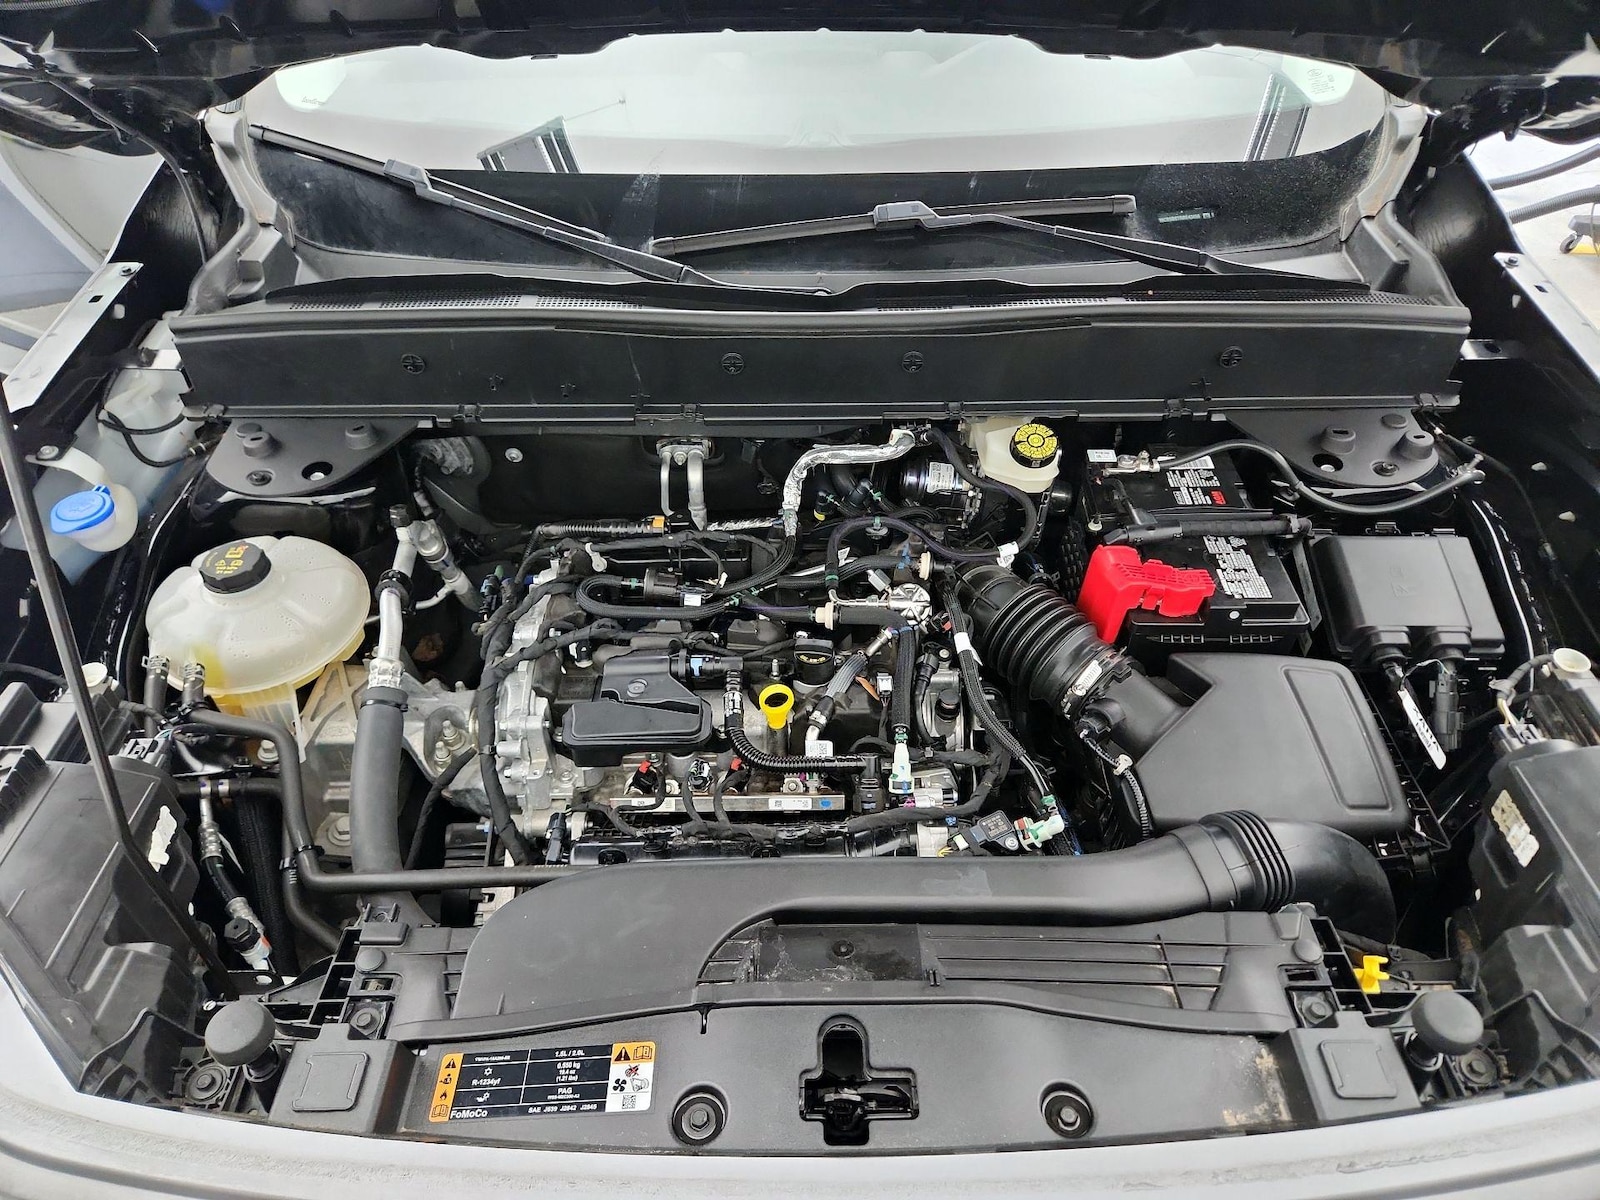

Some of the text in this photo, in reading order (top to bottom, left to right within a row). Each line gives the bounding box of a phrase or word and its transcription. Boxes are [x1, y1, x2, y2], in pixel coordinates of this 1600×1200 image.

[573, 1061, 580, 1069] kg
[471, 1078, 501, 1086] R-1234yf
[450, 1109, 488, 1119] FoMoCo
